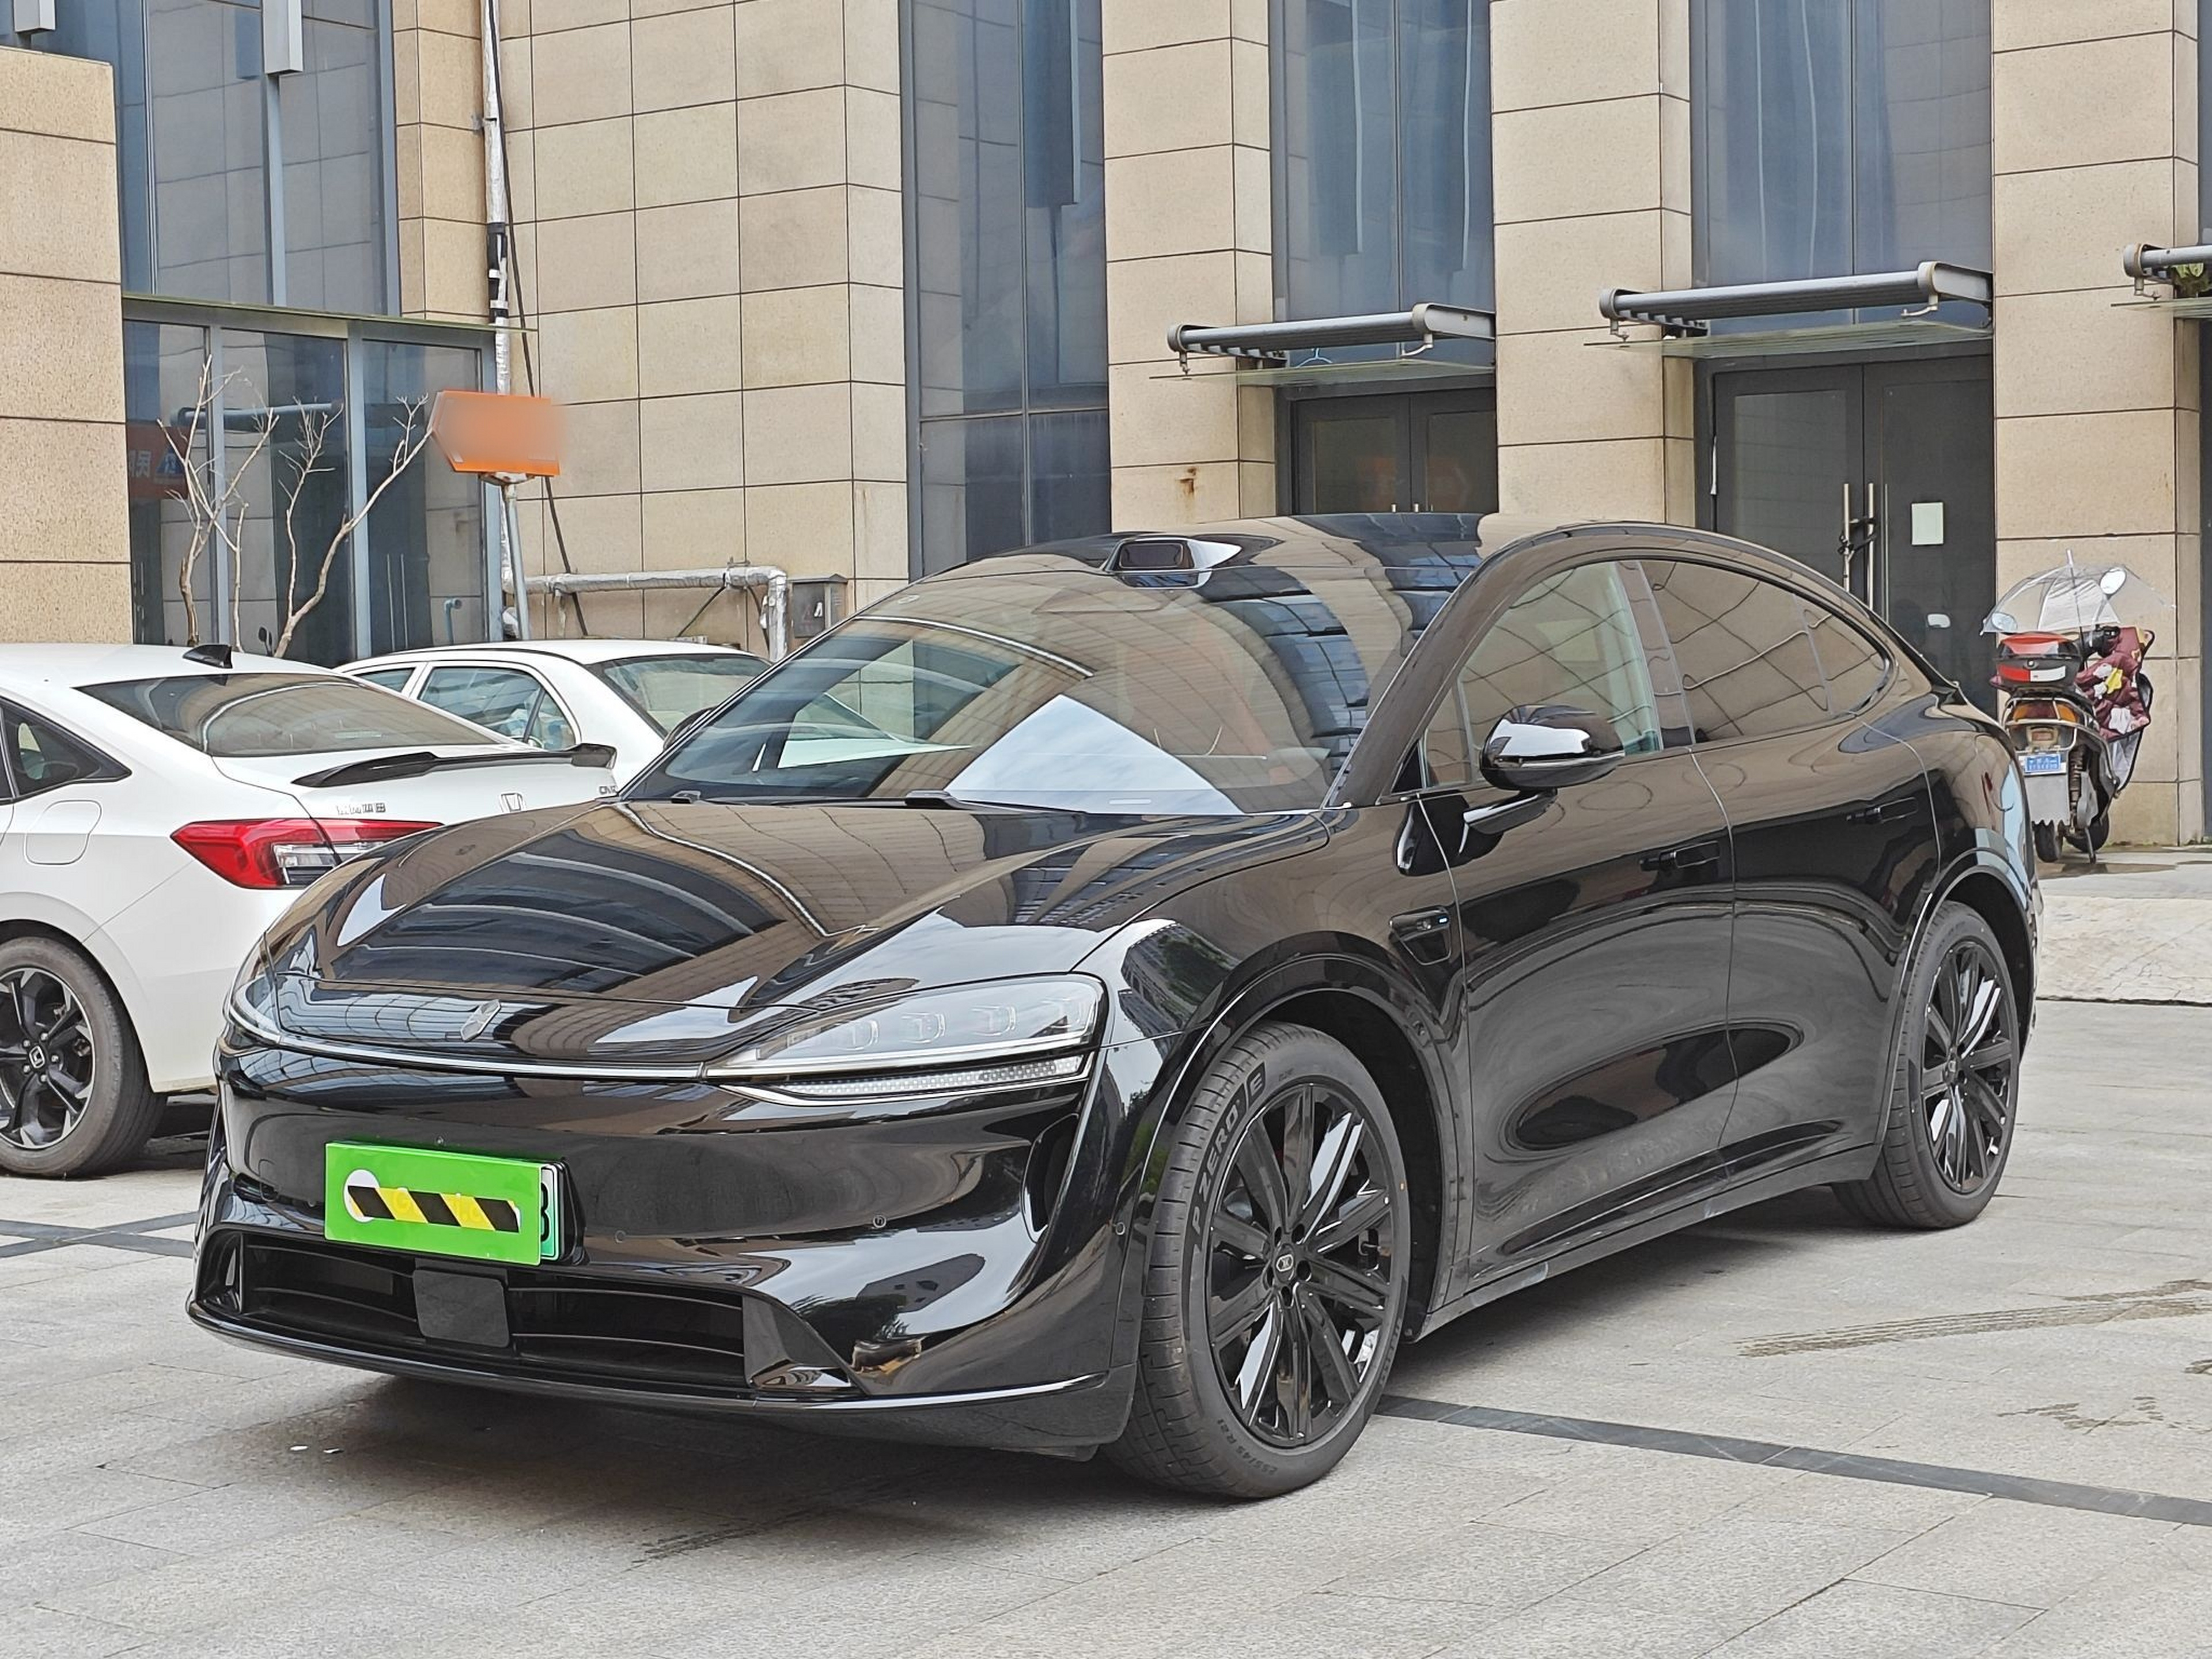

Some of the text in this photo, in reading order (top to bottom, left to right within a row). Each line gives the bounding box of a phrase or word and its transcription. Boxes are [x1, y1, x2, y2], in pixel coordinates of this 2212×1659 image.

[1192, 1073, 1263, 1235] P ZERO E
